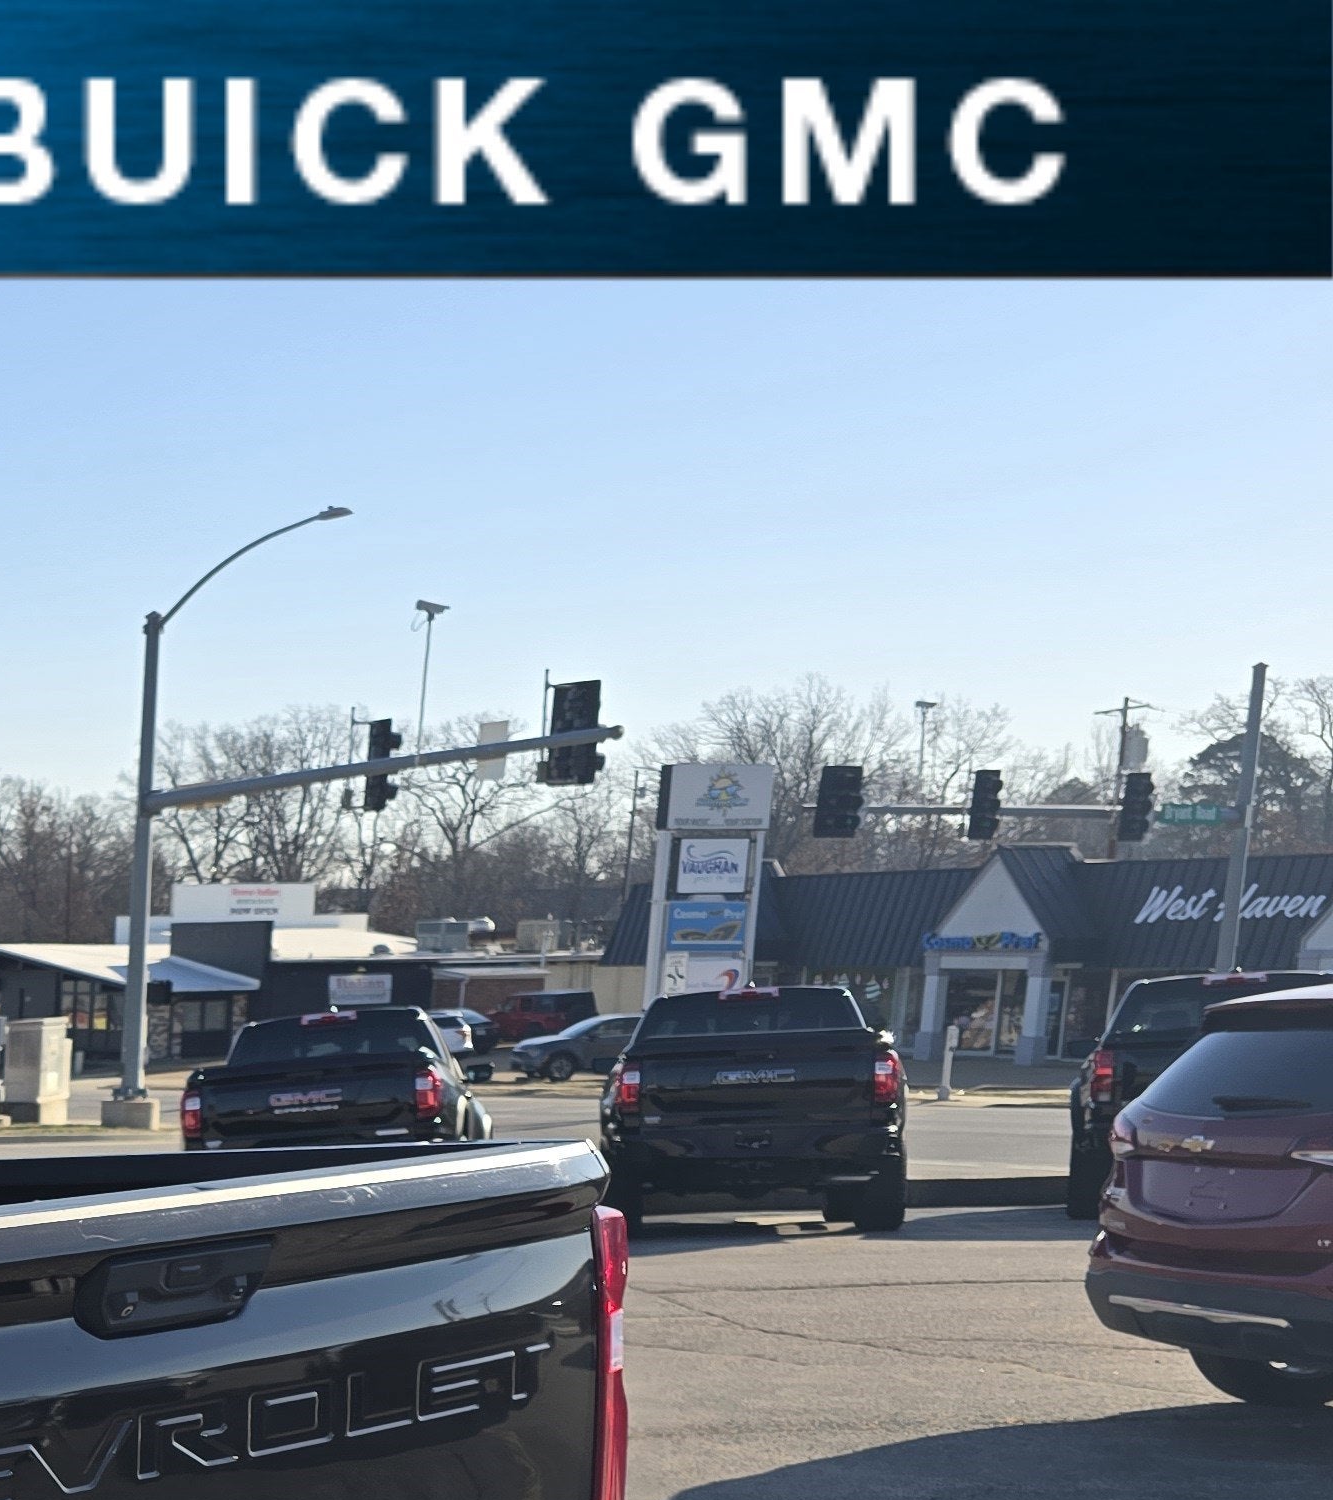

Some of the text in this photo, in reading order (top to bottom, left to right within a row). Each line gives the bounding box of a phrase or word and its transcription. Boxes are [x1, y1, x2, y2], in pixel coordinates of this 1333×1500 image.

[682, 859, 740, 875] VAUGHAN
[1134, 884, 1217, 924] West
[921, 931, 975, 951] Cosmo
[713, 1068, 796, 1085] GMC
[269, 1088, 343, 1107] GMC
